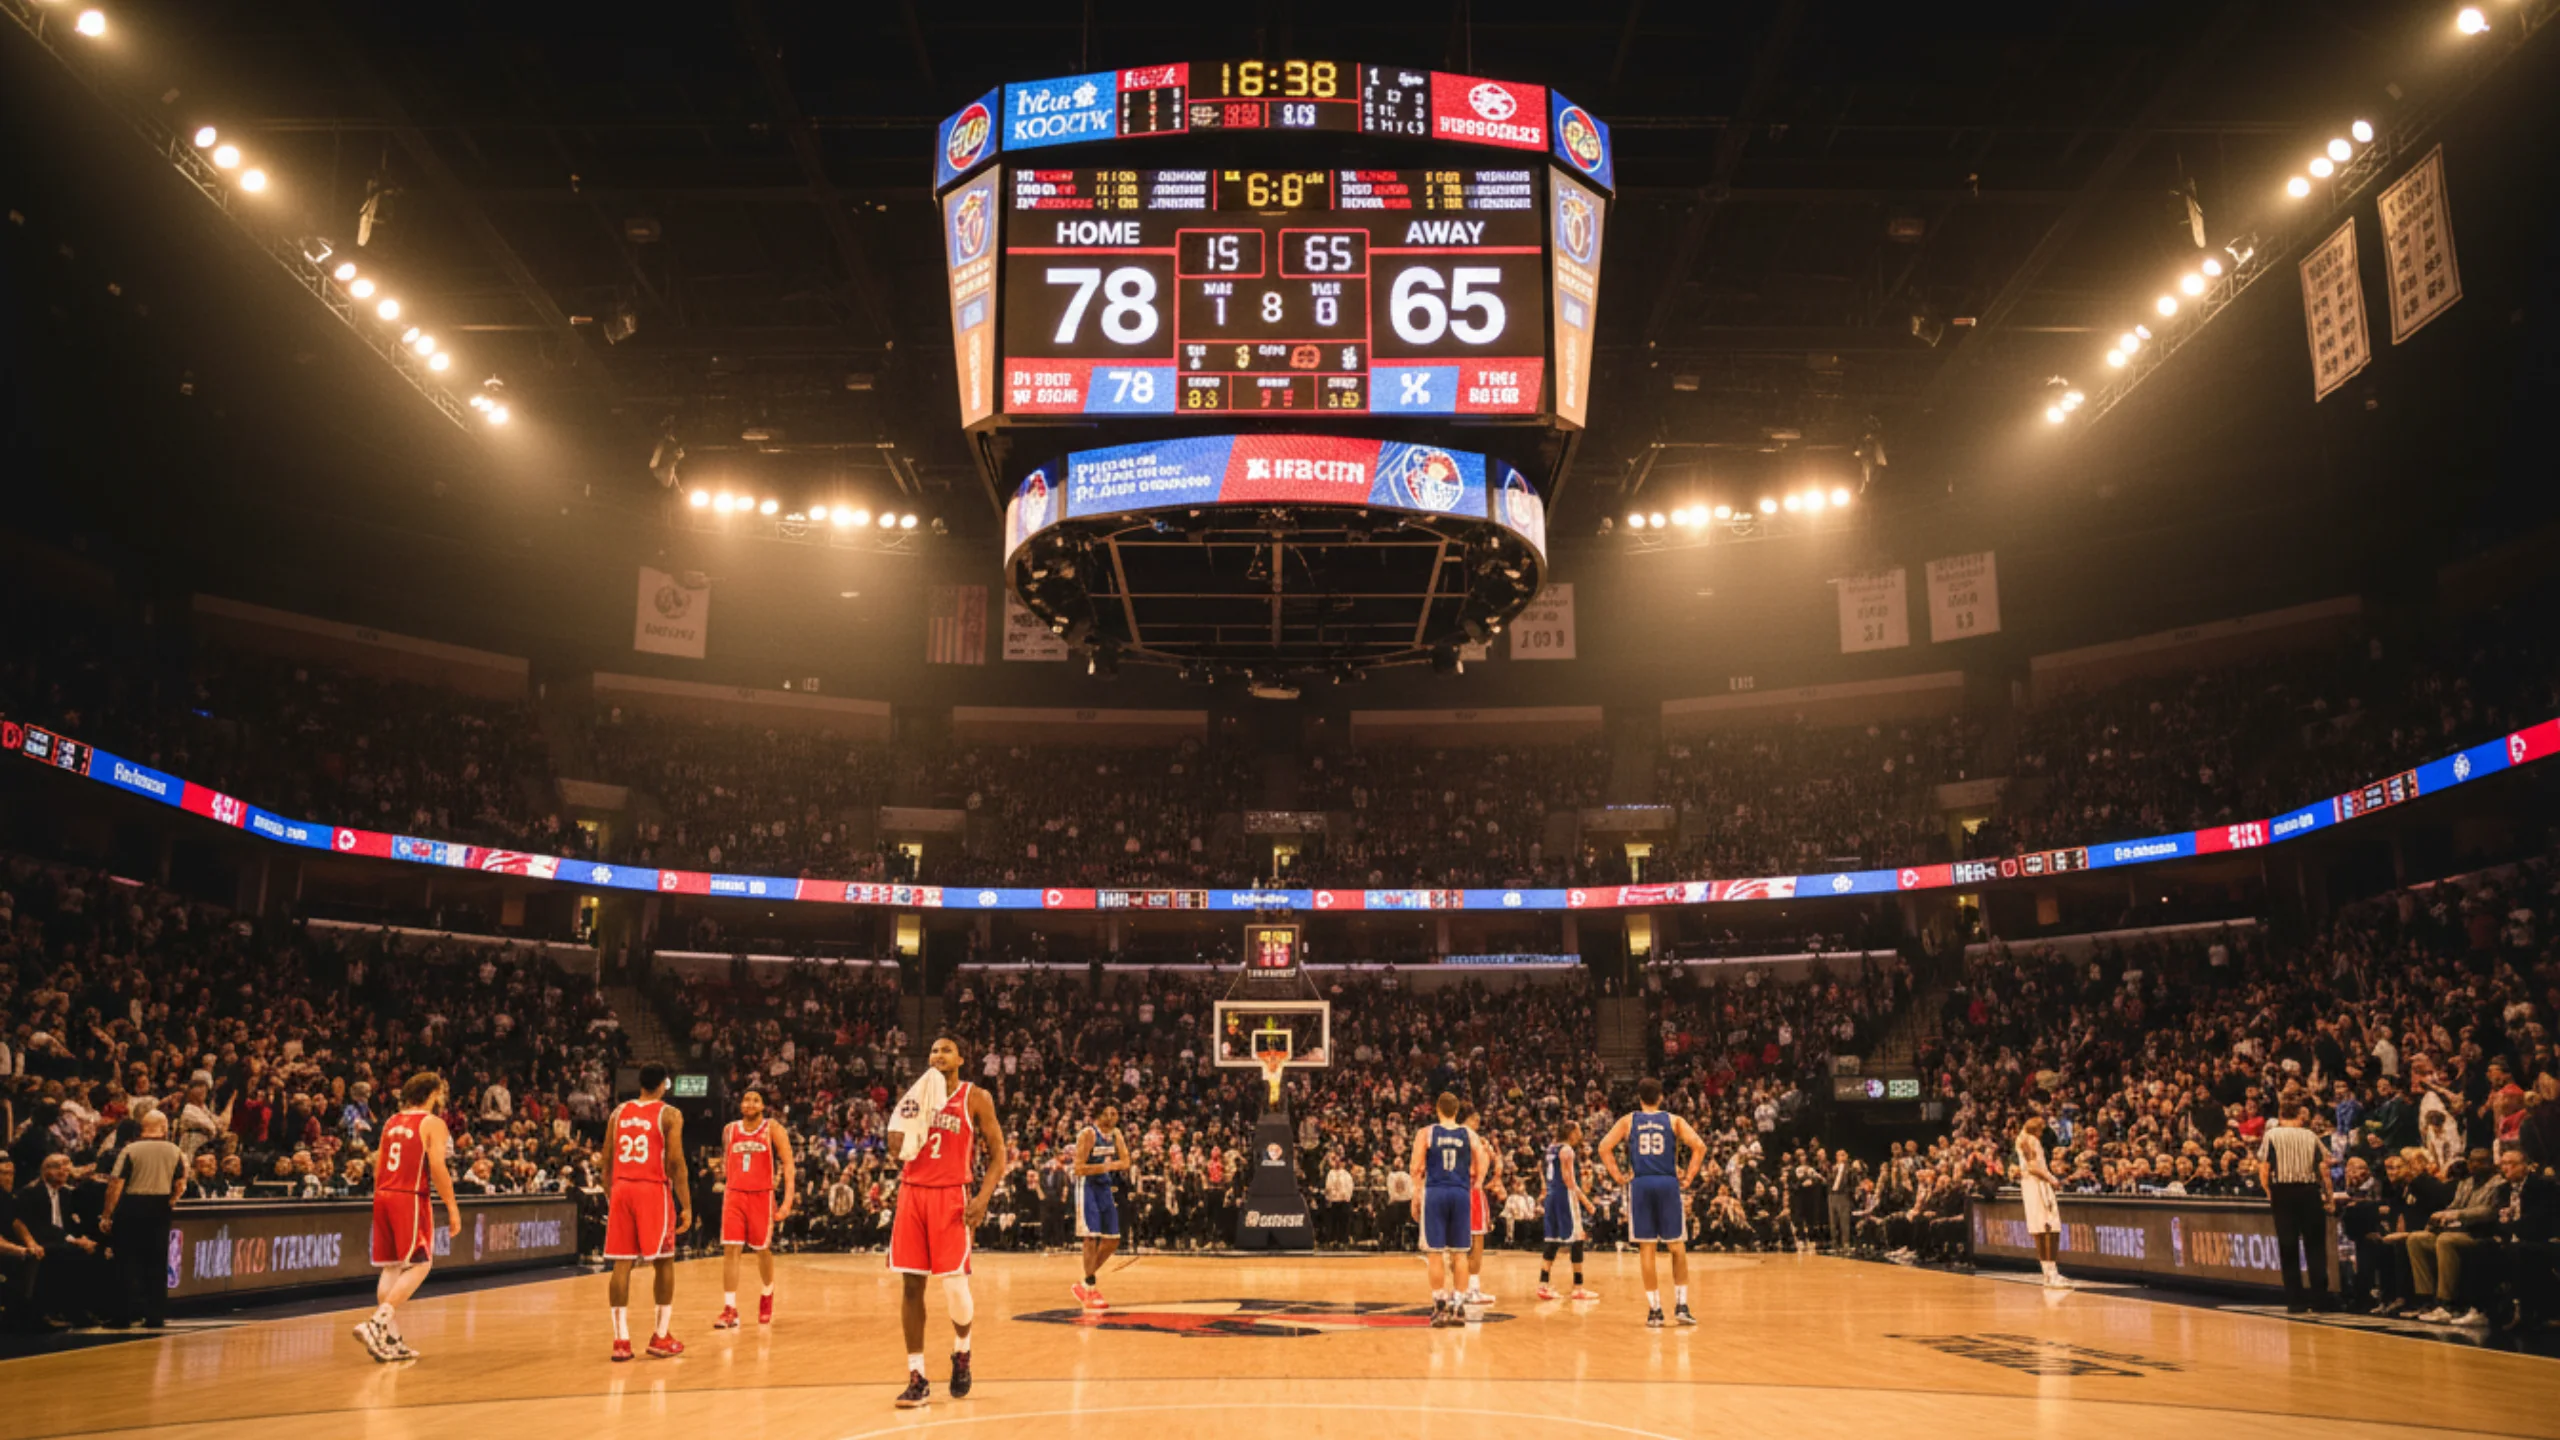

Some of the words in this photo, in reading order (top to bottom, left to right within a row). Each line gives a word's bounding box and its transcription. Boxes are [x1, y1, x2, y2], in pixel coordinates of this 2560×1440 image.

[1222, 61, 1337, 97] 16:38
[1056, 221, 1140, 245] HOME
[1405, 221, 1484, 244] AWAY
[1304, 235, 1353, 271] 65
[1046, 267, 1159, 344] 78
[1261, 291, 1283, 323] 8
[1390, 266, 1506, 345] 65
[1108, 371, 1155, 404] 78
